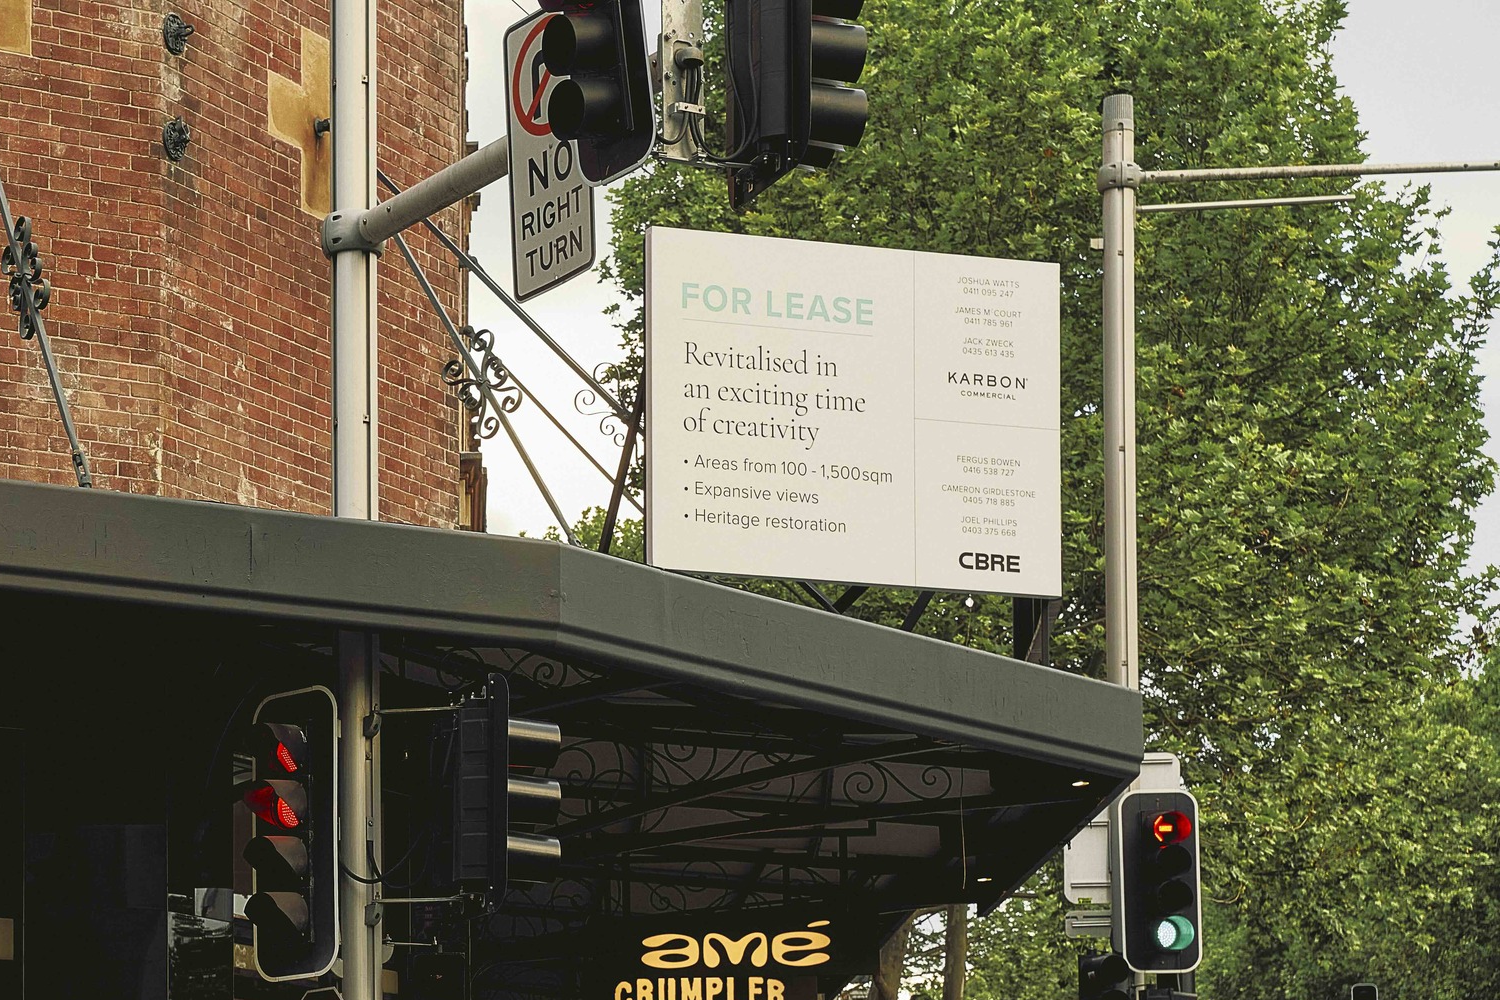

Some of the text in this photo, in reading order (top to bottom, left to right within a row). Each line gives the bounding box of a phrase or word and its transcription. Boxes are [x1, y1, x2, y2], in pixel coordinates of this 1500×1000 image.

[528, 139, 573, 197] NO
[522, 184, 583, 242] RIGHT
[525, 225, 583, 278] TURN
[957, 277, 1020, 289] JOSHUA WATTS
[963, 287, 1014, 298] 0411 095 247
[681, 282, 874, 326] FOR LEASE
[955, 307, 981, 316] JAMES
[964, 317, 1013, 328] 0411 785 961
[963, 337, 1014, 348] JACK ZWECK
[684, 341, 838, 377] Revitalised in
[962, 347, 1015, 358] 0435 613 435
[948, 371, 1026, 389] KARBON
[684, 382, 866, 416] an exciting time
[960, 390, 1017, 400] COMMERCIAL
[683, 407, 820, 450] of creativity
[694, 454, 738, 471] Areas
[743, 458, 777, 474] from
[781, 461, 807, 476] 100
[956, 455, 1021, 467] FERGUS BOWEN
[963, 466, 1015, 477] 0416 538 727
[695, 481, 819, 505] Expansive views
[941, 484, 1036, 499] CAMERON GIRDLESTONE
[962, 496, 1015, 507] 0405 718 885
[695, 509, 847, 533] Heritage restoration
[960, 516, 1018, 527] JOEL PHILLIPS
[961, 526, 1017, 537] 0403 375 668
[958, 551, 1021, 573] CBRE
[641, 920, 831, 969] amé
